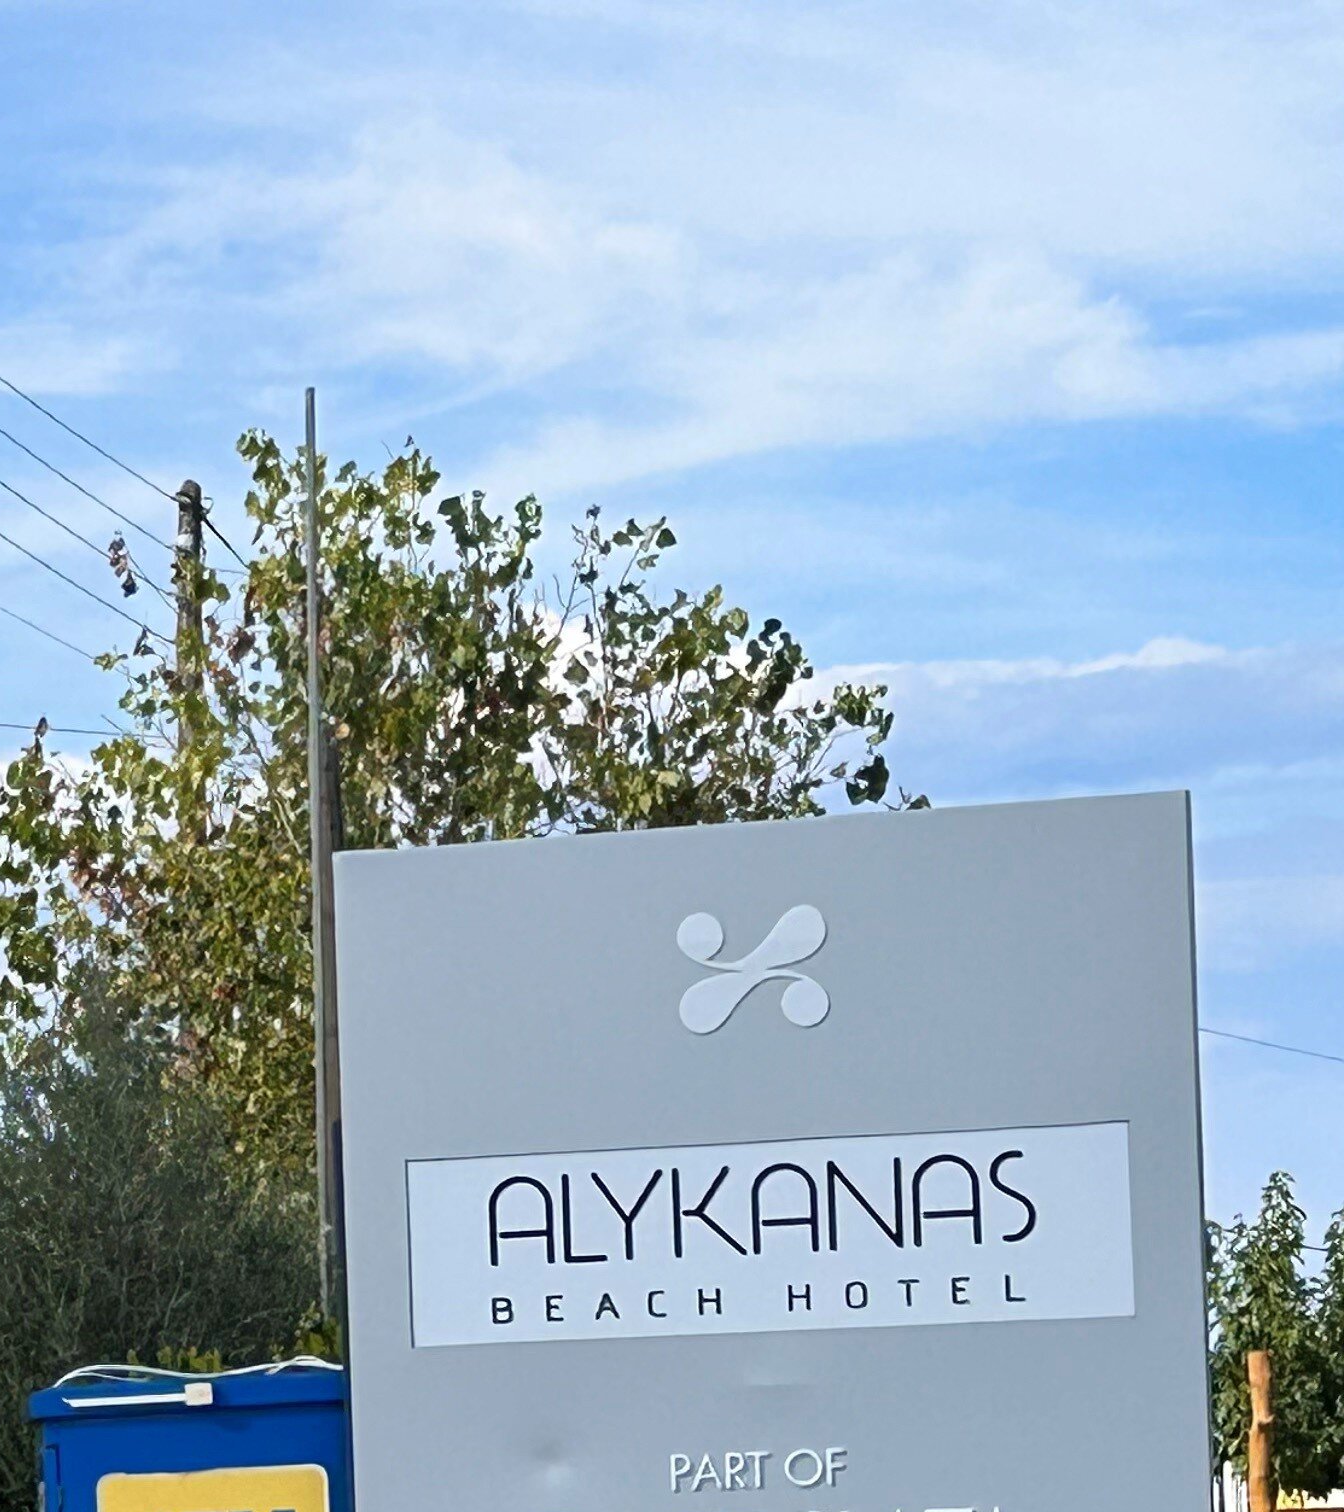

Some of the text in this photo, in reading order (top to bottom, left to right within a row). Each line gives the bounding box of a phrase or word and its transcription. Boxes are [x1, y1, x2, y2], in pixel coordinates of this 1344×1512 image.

[487, 1149, 1037, 1267] ALYKANAS
[490, 1273, 1027, 1325] BEACH HOTEL
[669, 1446, 849, 1492] PART OF
